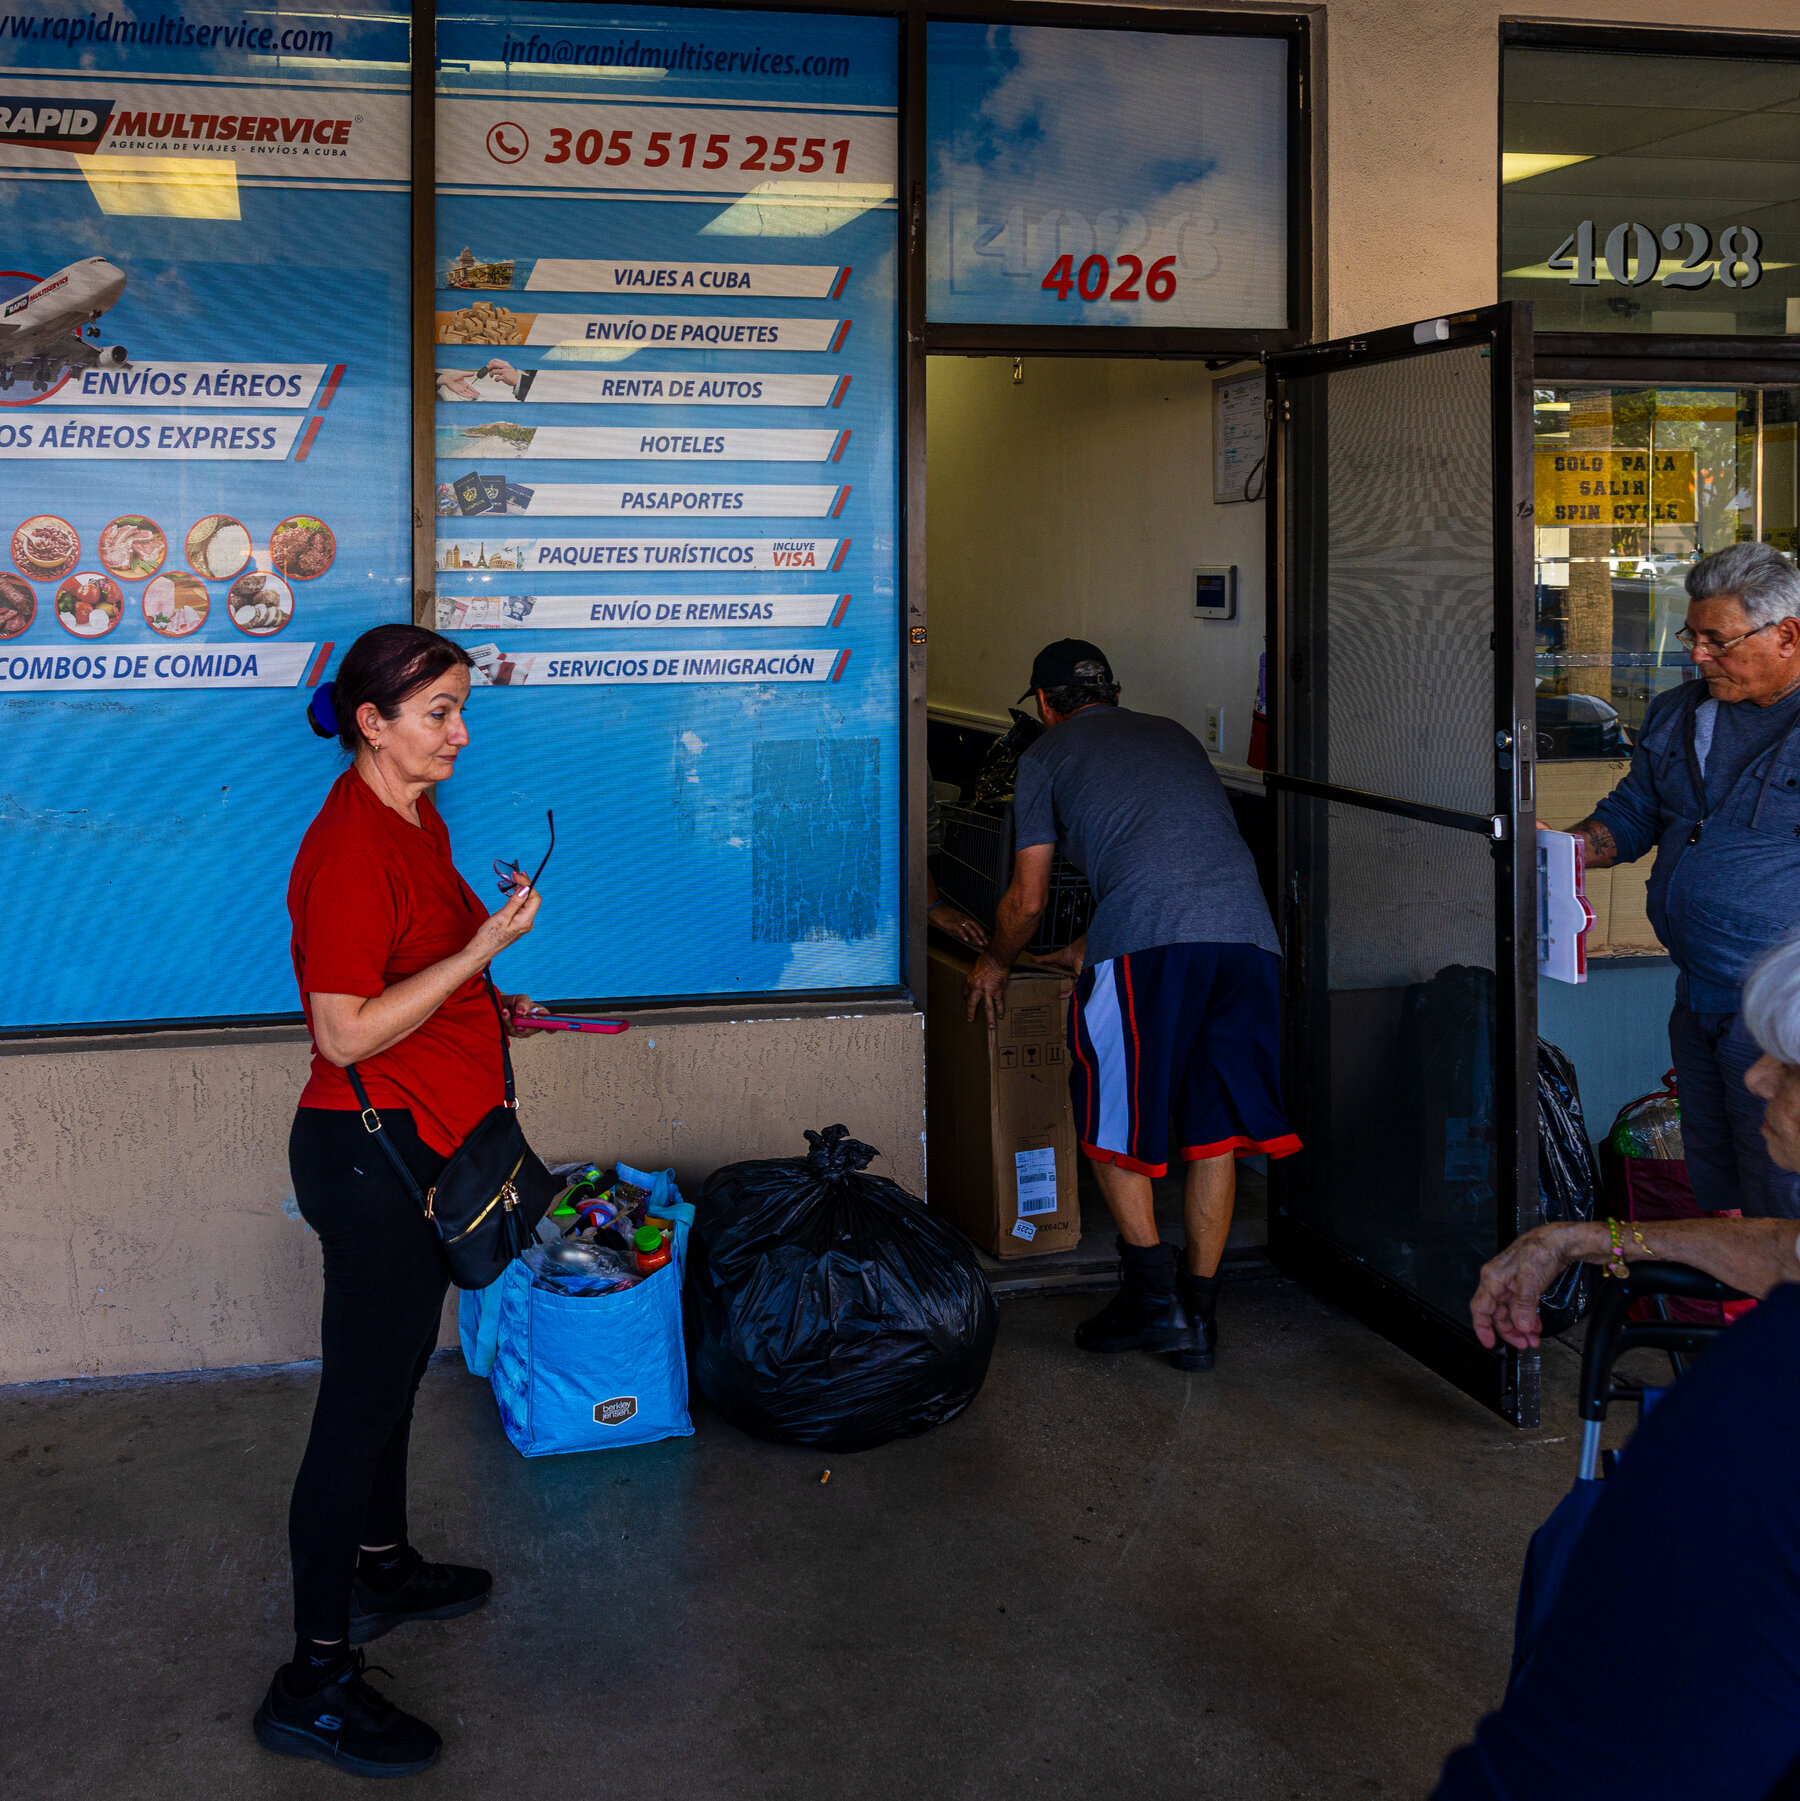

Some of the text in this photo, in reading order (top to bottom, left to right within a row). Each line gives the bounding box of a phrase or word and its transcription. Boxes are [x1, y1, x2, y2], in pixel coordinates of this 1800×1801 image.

[501, 34, 850, 78] info@rapidmultiservices.com
[0, 107, 98, 136] RAPID
[109, 141, 169, 150] AGENCIA
[173, 143, 188, 151] DE
[193, 144, 237, 153] VIAJES
[250, 145, 298, 155] ENVÍOS
[302, 148, 310, 156] A
[315, 148, 348, 157] CUBA
[544, 127, 851, 175] 305 515 2551
[1548, 220, 1763, 290] 4028
[614, 268, 752, 290] VIAJES A CUBA
[1041, 254, 1177, 302] 4026
[585, 319, 779, 345] ENVÍO DE PAQUETES
[82, 367, 302, 397] ENVÍOS AÉREOS
[601, 379, 763, 399] RENTA DE AUTOS
[39, 420, 151, 449] AÉREOS
[157, 425, 277, 449] EXPRESS
[640, 435, 725, 454] HOTELES
[1554, 456, 1603, 472] SOLO
[1579, 480, 1645, 496] SALIR
[620, 491, 744, 510] PASAPORTES
[1555, 504, 1601, 520] SPIN
[538, 541, 754, 566] PAQUETES TURÍSTICOS
[772, 541, 816, 552] INCLUYE
[772, 551, 816, 568] VISA
[590, 600, 774, 622] ENVÍO DE REMESAS
[113, 655, 149, 679] DE
[154, 653, 259, 678] COMIDA
[547, 653, 815, 679] SERVICIOS DE INMIGRACIÓN
[1016, 1224, 1034, 1236] C225
[602, 1401, 632, 1413] berkley
[602, 1408, 630, 1422] jensen
